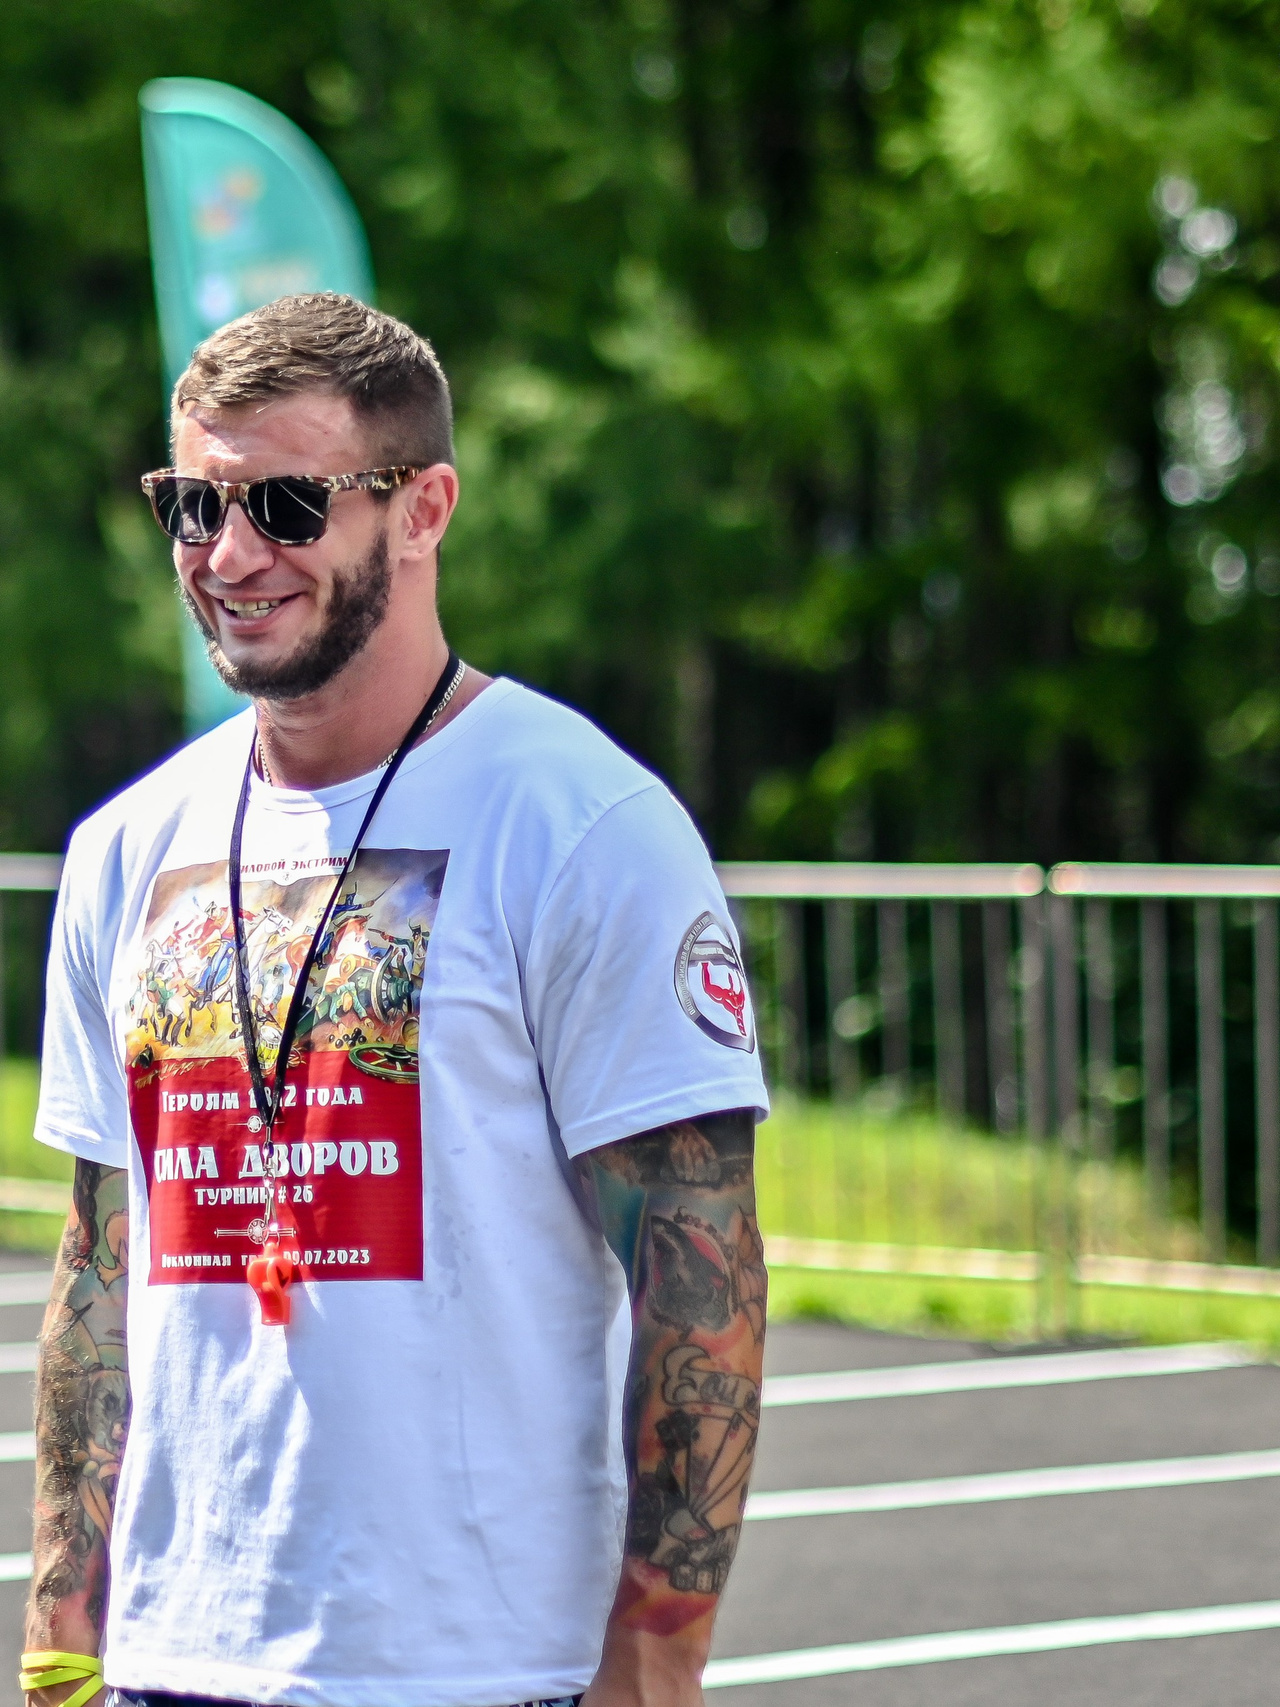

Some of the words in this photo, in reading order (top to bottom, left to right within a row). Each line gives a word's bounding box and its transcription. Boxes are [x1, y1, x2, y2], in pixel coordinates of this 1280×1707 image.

[240, 859, 286, 874] ИЛОВОЙ
[291, 856, 349, 871] ЭКСТРИМ
[161, 1091, 240, 1113] ГЕРОЯМ
[305, 1086, 364, 1106] ГОДА
[154, 1146, 219, 1183] СИЛА
[238, 1141, 400, 1179] ДВОРОВ
[278, 1186, 287, 1203] #
[293, 1184, 314, 1203] 26
